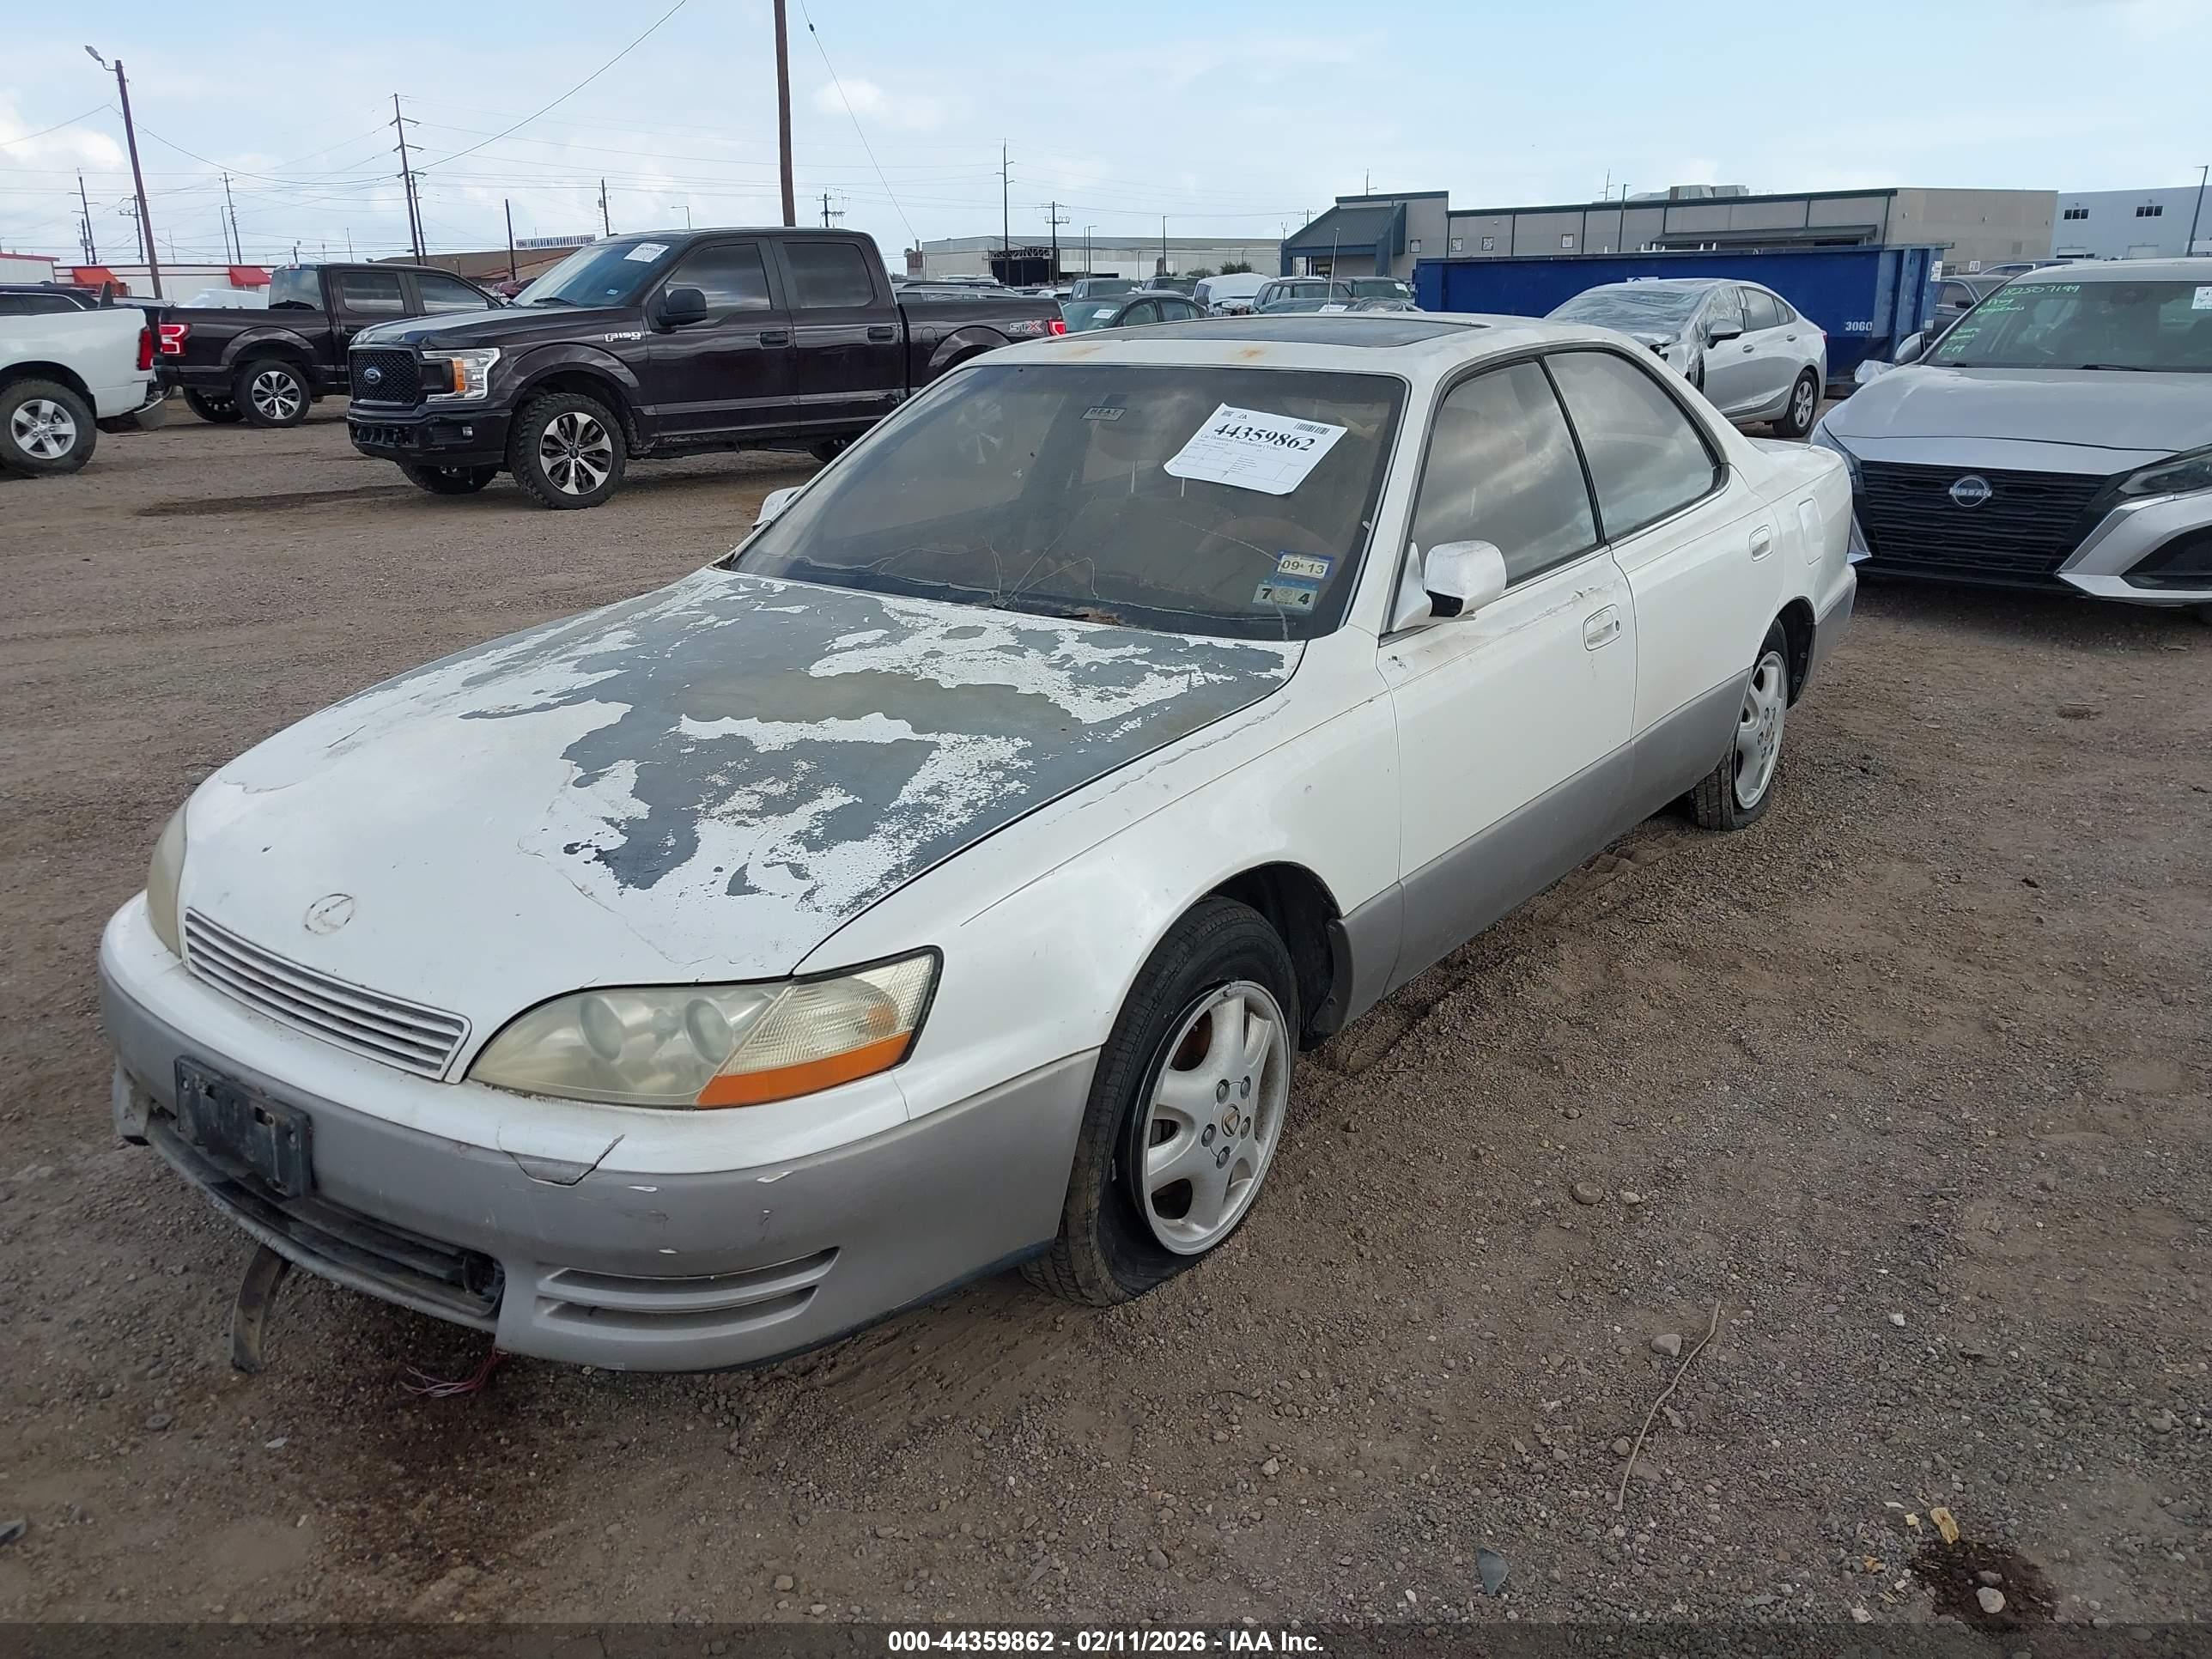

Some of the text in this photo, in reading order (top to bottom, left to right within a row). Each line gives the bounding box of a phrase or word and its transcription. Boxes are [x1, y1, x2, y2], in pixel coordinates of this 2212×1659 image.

[1009, 320, 1044, 333] STX
[1845, 321, 1873, 331] 3060
[1214, 423, 1316, 451] 44359862
[1949, 487, 1992, 497] NISSAN
[1282, 560, 1325, 574] 09 13
[1262, 588, 1273, 599] 7
[1297, 593, 1310, 605] 4
